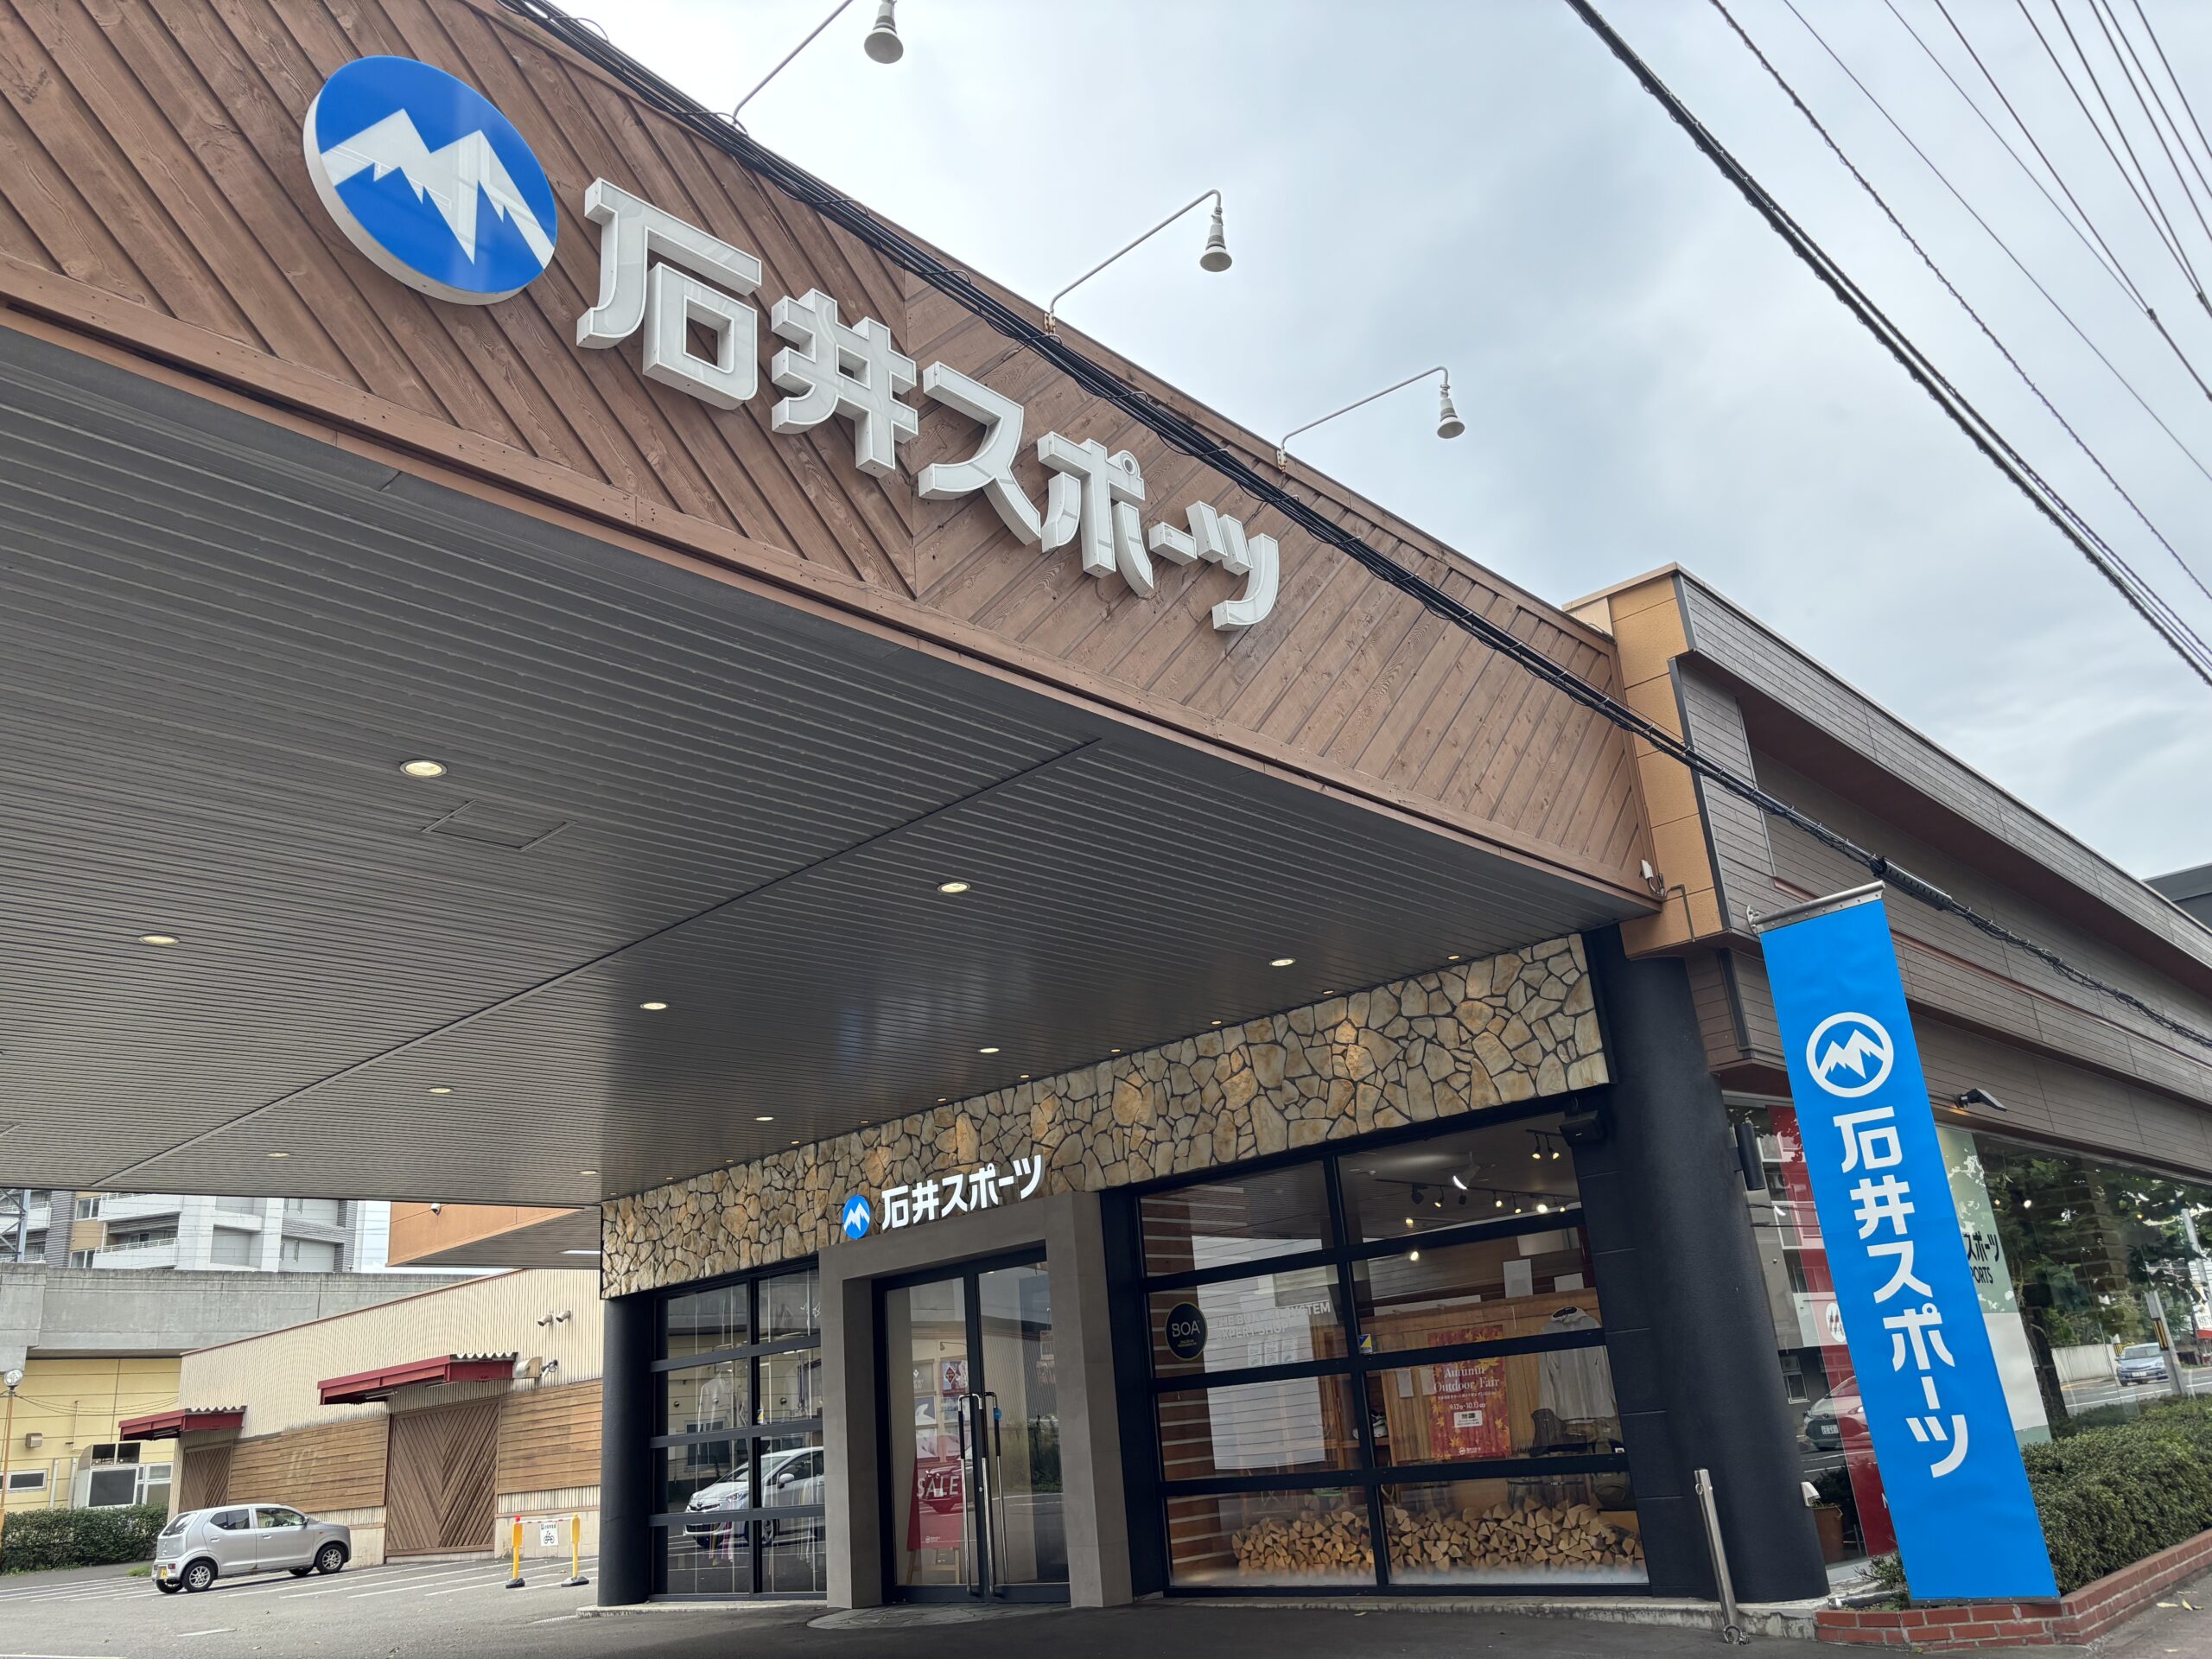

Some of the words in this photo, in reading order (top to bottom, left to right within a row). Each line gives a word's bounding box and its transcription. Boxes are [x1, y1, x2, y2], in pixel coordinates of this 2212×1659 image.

[576, 177, 1280, 632] 石井スポーツ
[881, 1154, 1042, 1230] 石井スポーツ
[1833, 1106, 1969, 1478] 石井スポーツ
[1171, 1319, 1201, 1338] BOA
[1220, 1325, 1256, 1339] XPERT
[1444, 1367, 1485, 1378] Autumn
[1434, 1380, 1475, 1392] Outdoor
[1479, 1376, 1500, 1388] Fair
[917, 1475, 960, 1499] SALE
